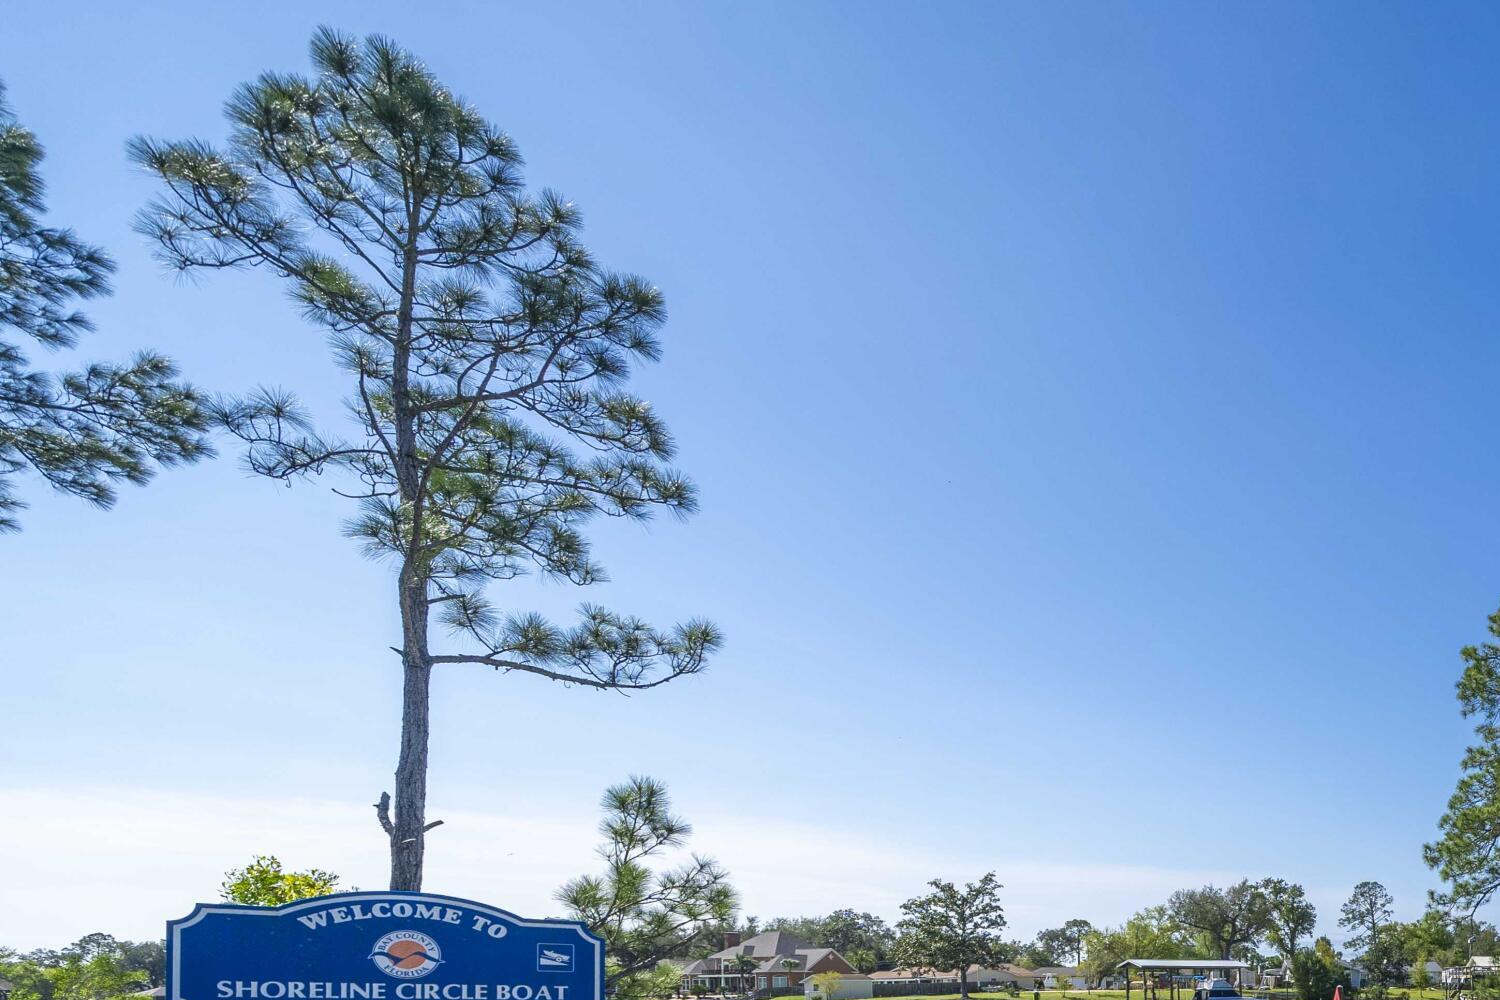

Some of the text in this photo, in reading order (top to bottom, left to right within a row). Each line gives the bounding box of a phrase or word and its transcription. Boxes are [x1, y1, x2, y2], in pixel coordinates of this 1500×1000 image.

[297, 903, 508, 939] WELCOME TO
[378, 933, 436, 952] BAY COUNTY
[384, 965, 429, 976] FLORIDA
[216, 980, 569, 1000] SHORELINE CIRCLE BOAT
